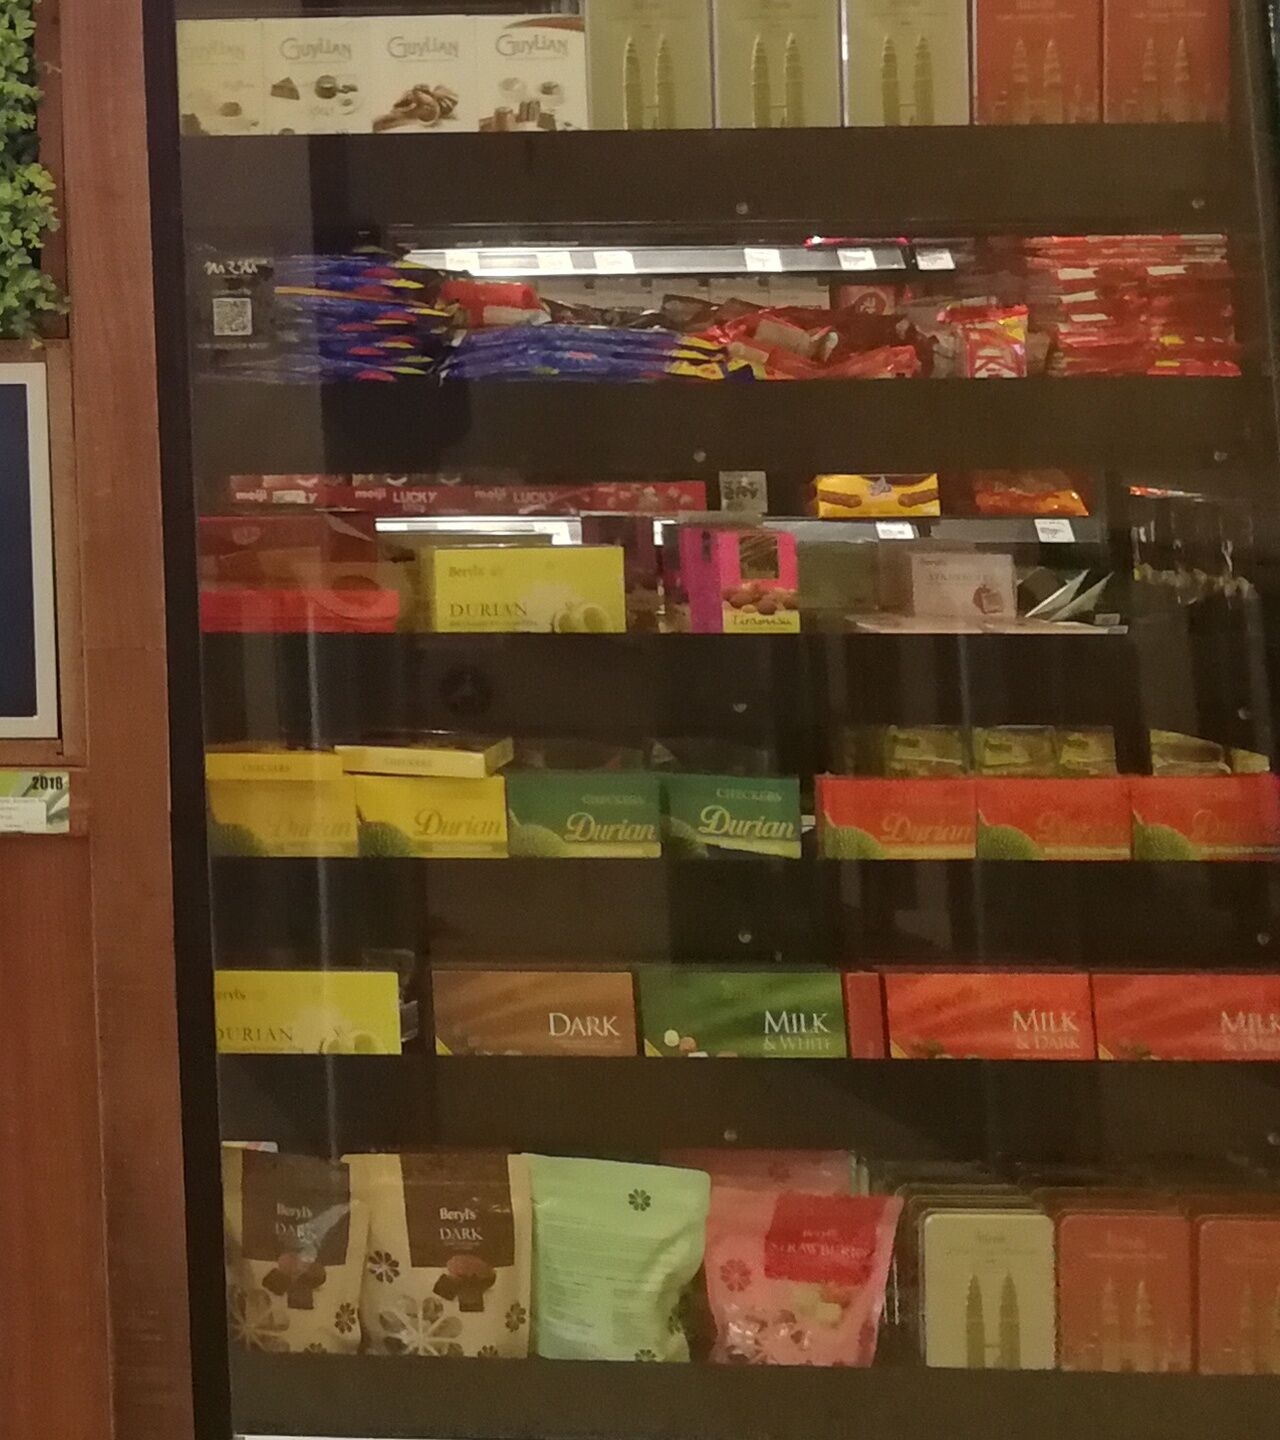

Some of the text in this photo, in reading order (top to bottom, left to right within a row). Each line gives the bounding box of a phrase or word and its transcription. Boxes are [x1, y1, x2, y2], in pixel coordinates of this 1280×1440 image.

[449, 601, 528, 618] DURIAN
[31, 775, 65, 791] 2018
[413, 808, 502, 837] Durian
[564, 811, 655, 843] Durian
[698, 804, 795, 840] Durian
[548, 1011, 620, 1038] DARK
[763, 1009, 833, 1035] MILK
[1011, 1009, 1079, 1033] MILK
[440, 1206, 477, 1224] Beryl's
[439, 1228, 484, 1242] DARK
